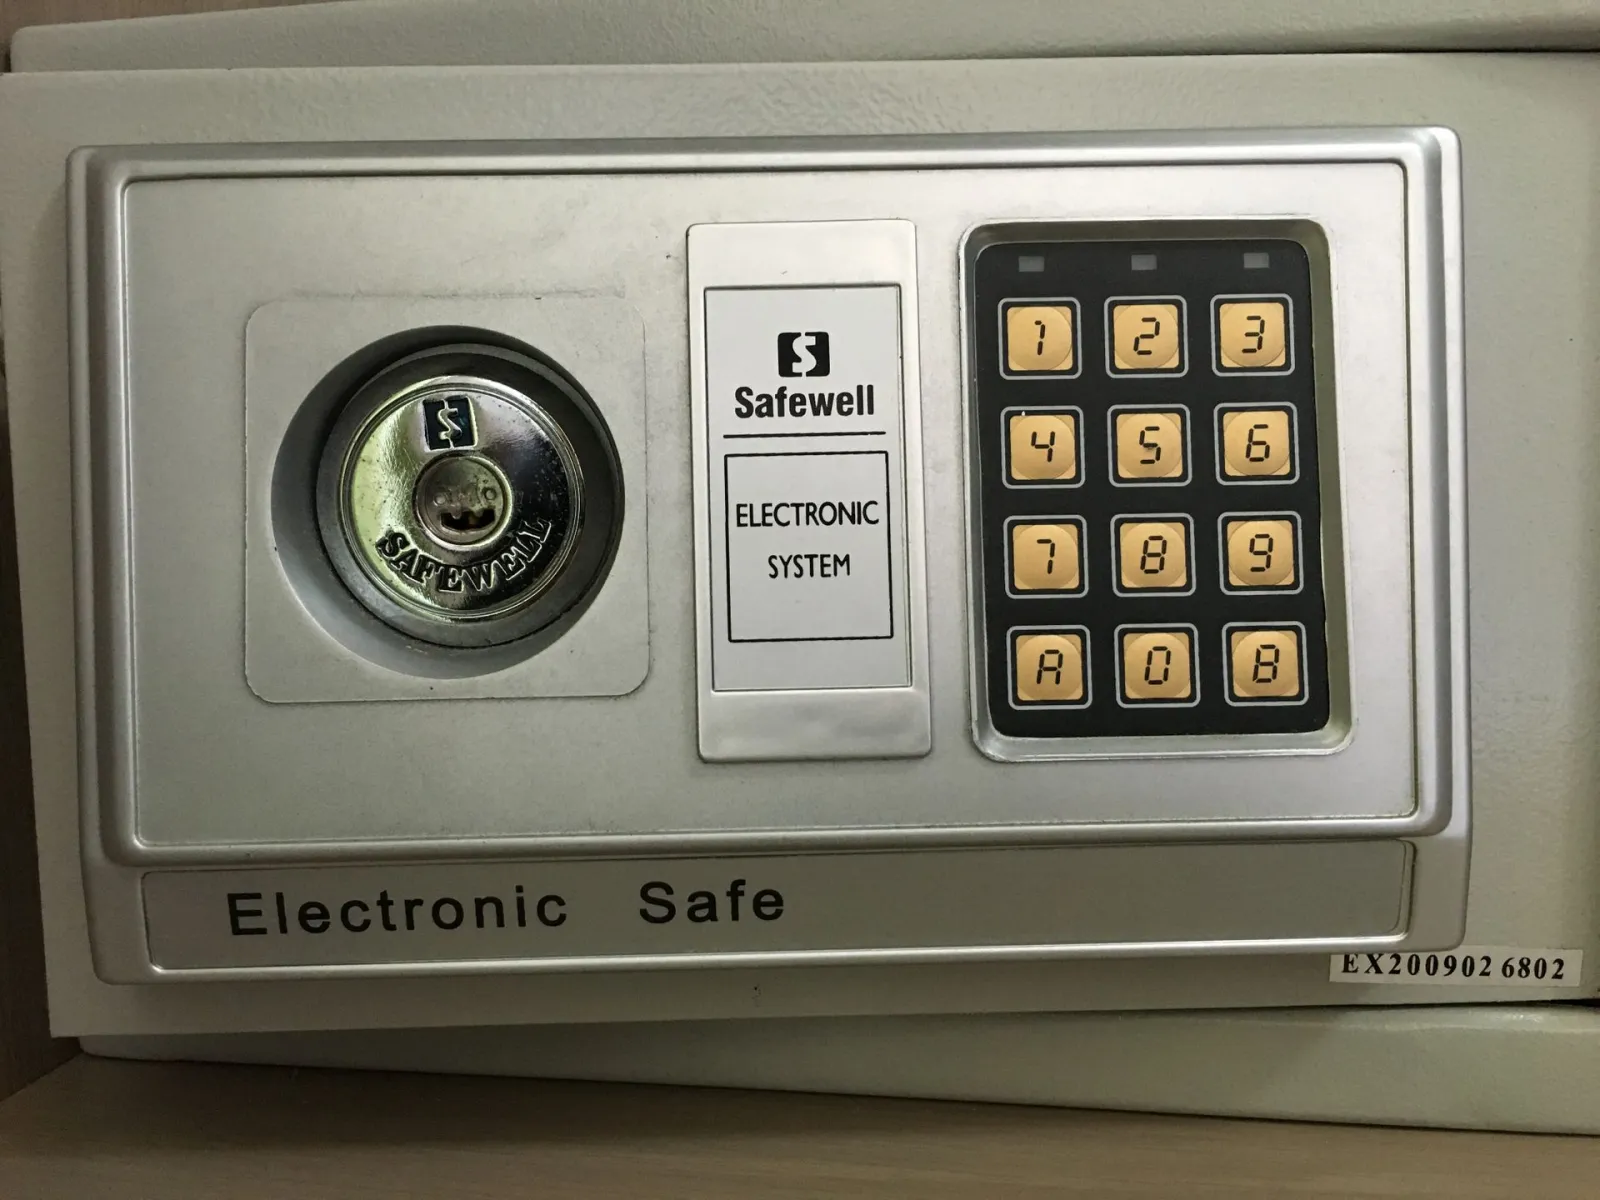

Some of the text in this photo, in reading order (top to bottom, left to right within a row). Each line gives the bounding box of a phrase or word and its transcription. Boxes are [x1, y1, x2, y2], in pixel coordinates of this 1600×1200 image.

[1035, 320, 1046, 356] 1
[1133, 317, 1161, 355] 2
[1241, 315, 1265, 353] 3
[734, 384, 875, 419] Safewell
[1030, 431, 1056, 463] 4
[1139, 426, 1161, 464] 5
[1245, 424, 1271, 462] 6
[736, 500, 880, 528] ELECTRONIC
[375, 520, 552, 593] SAFEWELL
[767, 554, 851, 579] SYSTEM
[1036, 538, 1056, 574] 7
[1140, 535, 1167, 574] 8
[1249, 533, 1274, 572] 9
[1036, 649, 1061, 685] A
[227, 879, 786, 936] Electronic Safe
